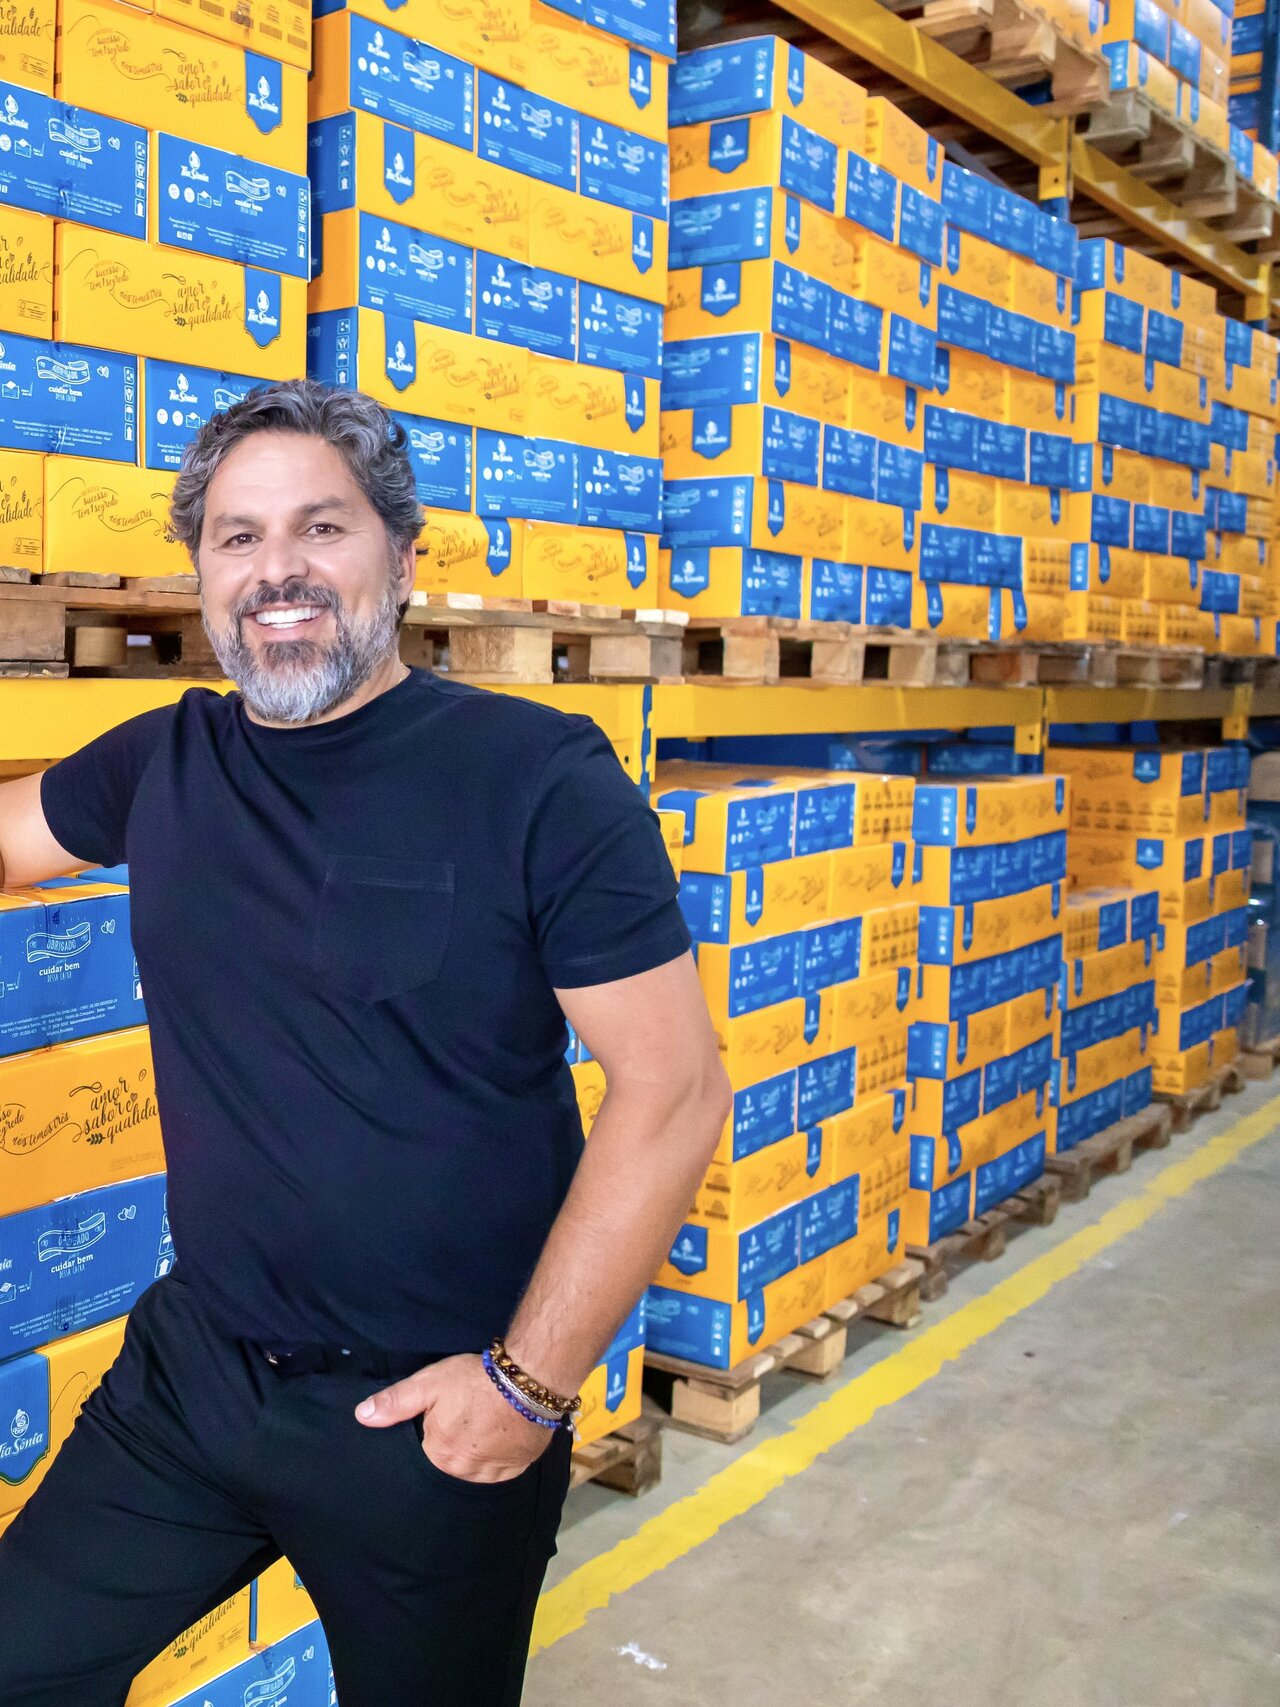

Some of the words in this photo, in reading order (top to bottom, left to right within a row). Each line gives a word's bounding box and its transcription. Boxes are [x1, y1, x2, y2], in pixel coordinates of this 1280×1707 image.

[39, 964, 64, 977] cuidar
[64, 961, 80, 972] bem
[91, 1077, 129, 1111] amor
[106, 1097, 158, 1144] qualida
[51, 1259, 76, 1274] cuidar
[77, 1253, 94, 1264] bem
[12, 1432, 44, 1455] Sônia
